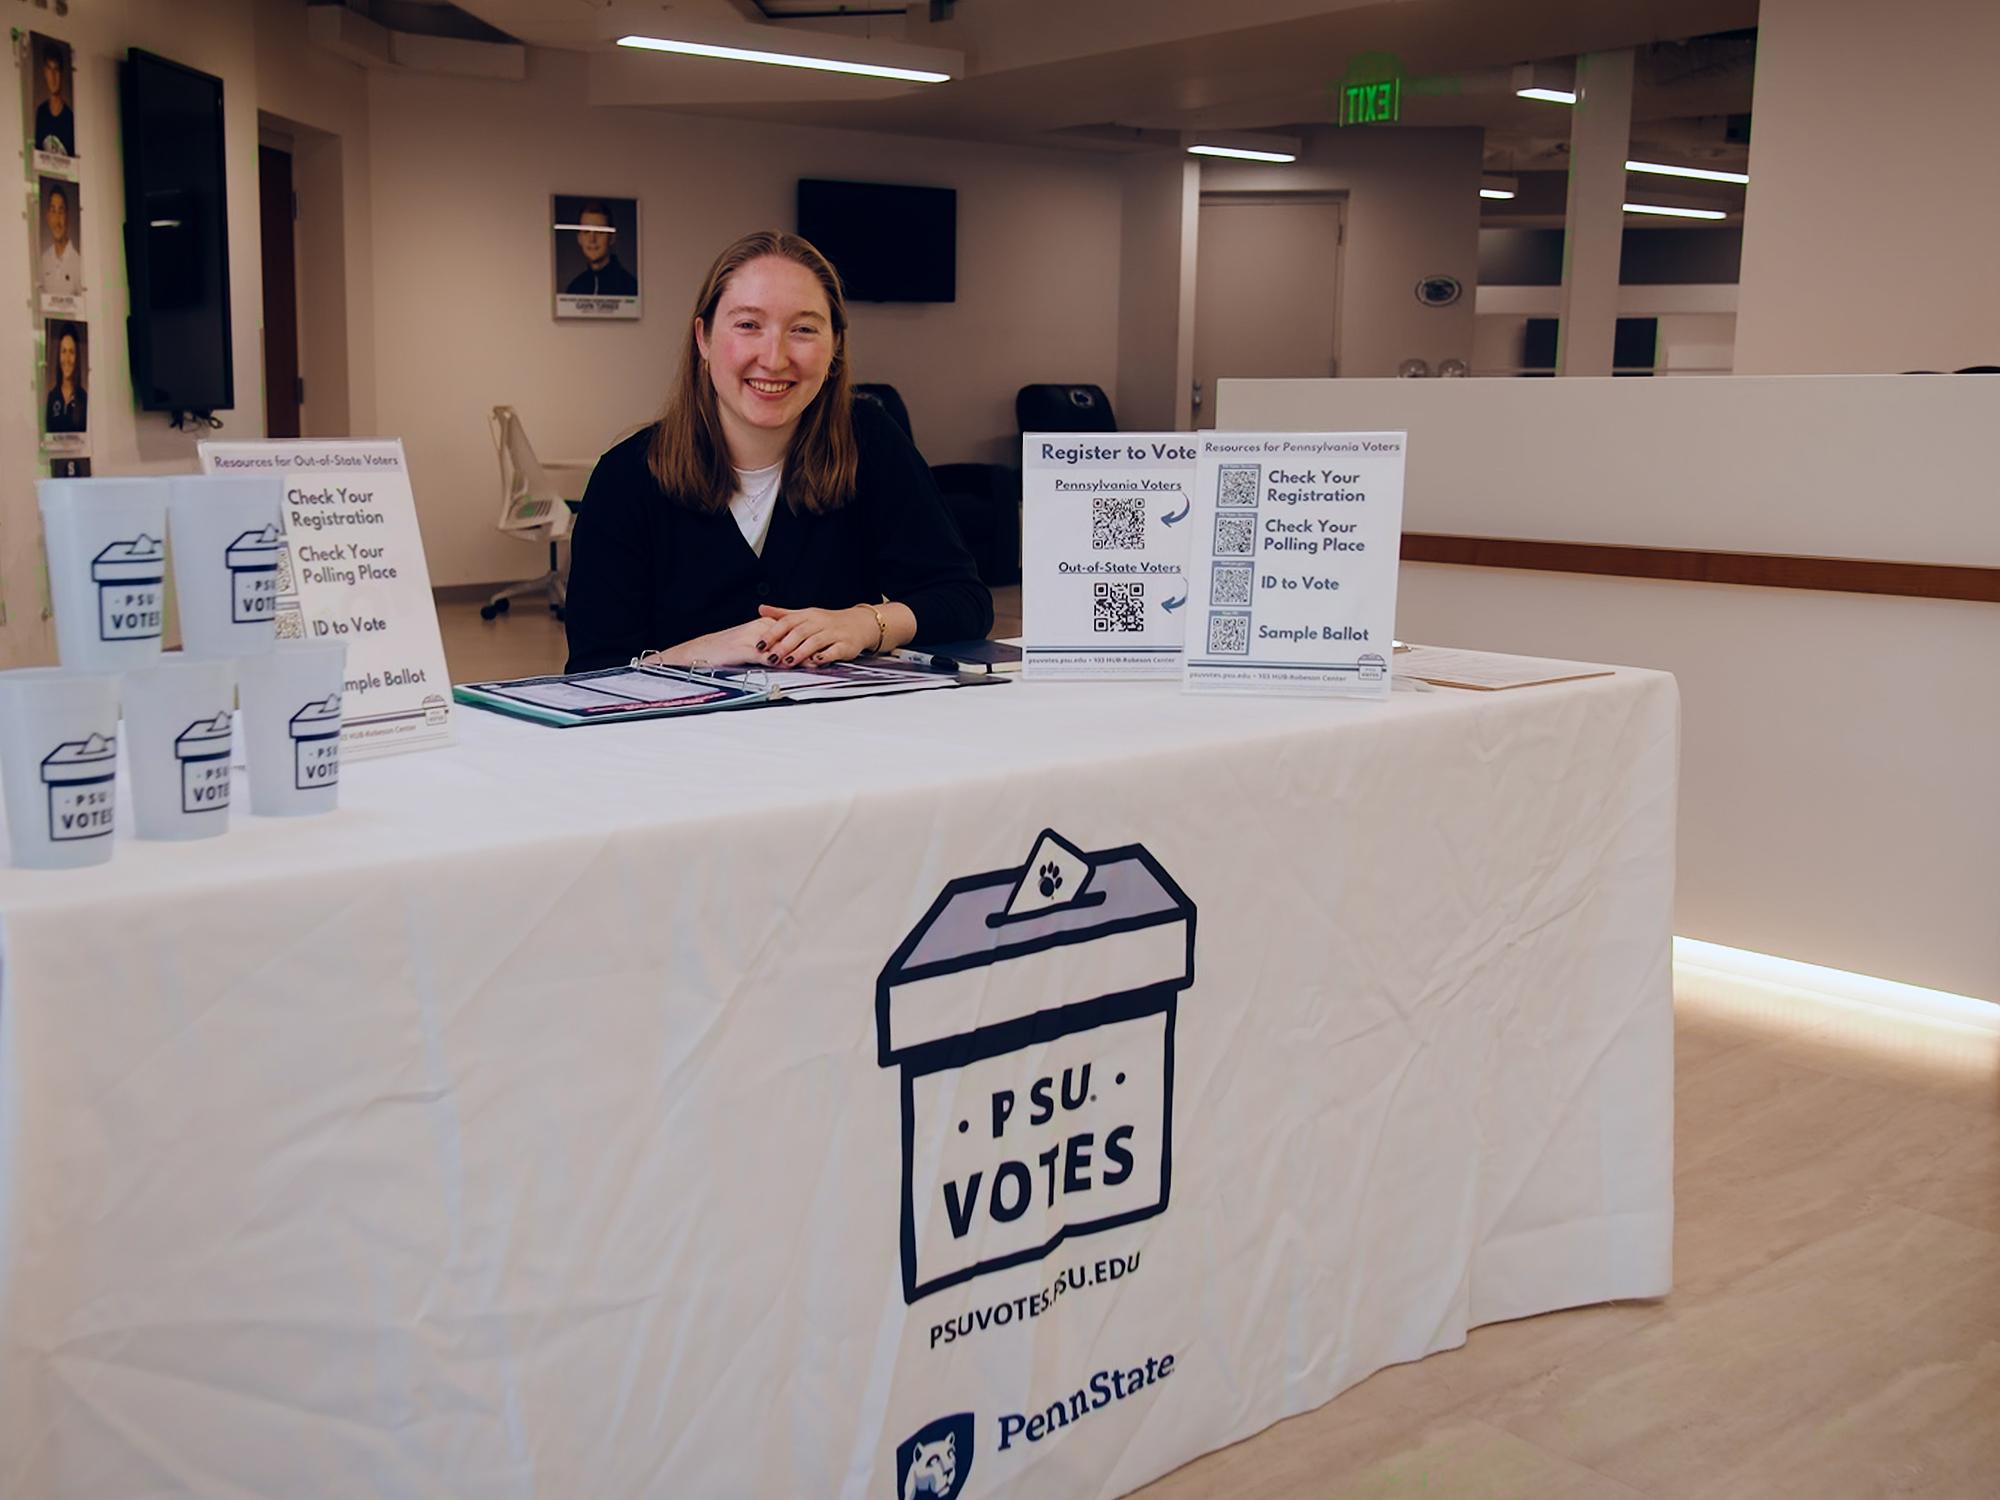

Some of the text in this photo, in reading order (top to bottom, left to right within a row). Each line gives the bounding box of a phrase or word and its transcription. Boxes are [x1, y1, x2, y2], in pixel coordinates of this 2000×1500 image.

[1042, 443, 1197, 464] Register to Vote
[1205, 442, 1400, 454] Resources for Pennsylvania Voters
[214, 454, 398, 468] Resources for Out-of-State Voters
[1268, 470, 1360, 484] Check Your
[1056, 480, 1182, 492] Pennsylvania Voters
[287, 488, 374, 505] Check Your
[1267, 488, 1366, 506] Registration
[291, 511, 384, 530] Registration
[1265, 520, 1357, 533] Check Your
[298, 546, 384, 562] Check Your
[1264, 538, 1366, 554] Polling Place
[303, 565, 398, 585] Polling Place
[1058, 562, 1181, 572] Out-of-State Voters
[1261, 576, 1340, 590] ID to Vote
[126, 594, 155, 606] PSU
[243, 597, 276, 612] VOTE
[312, 617, 387, 636] ID to Vote
[1258, 626, 1369, 642] Sample Ballot
[342, 668, 426, 694] mple Ballot
[194, 782, 230, 802] VOTE
[992, 1063, 1092, 1138] PSU
[943, 1125, 1134, 1239] VOTES
[930, 1251, 1141, 1350] PSUVOTES.PSU.EDU
[998, 1353, 1175, 1453] PennState
